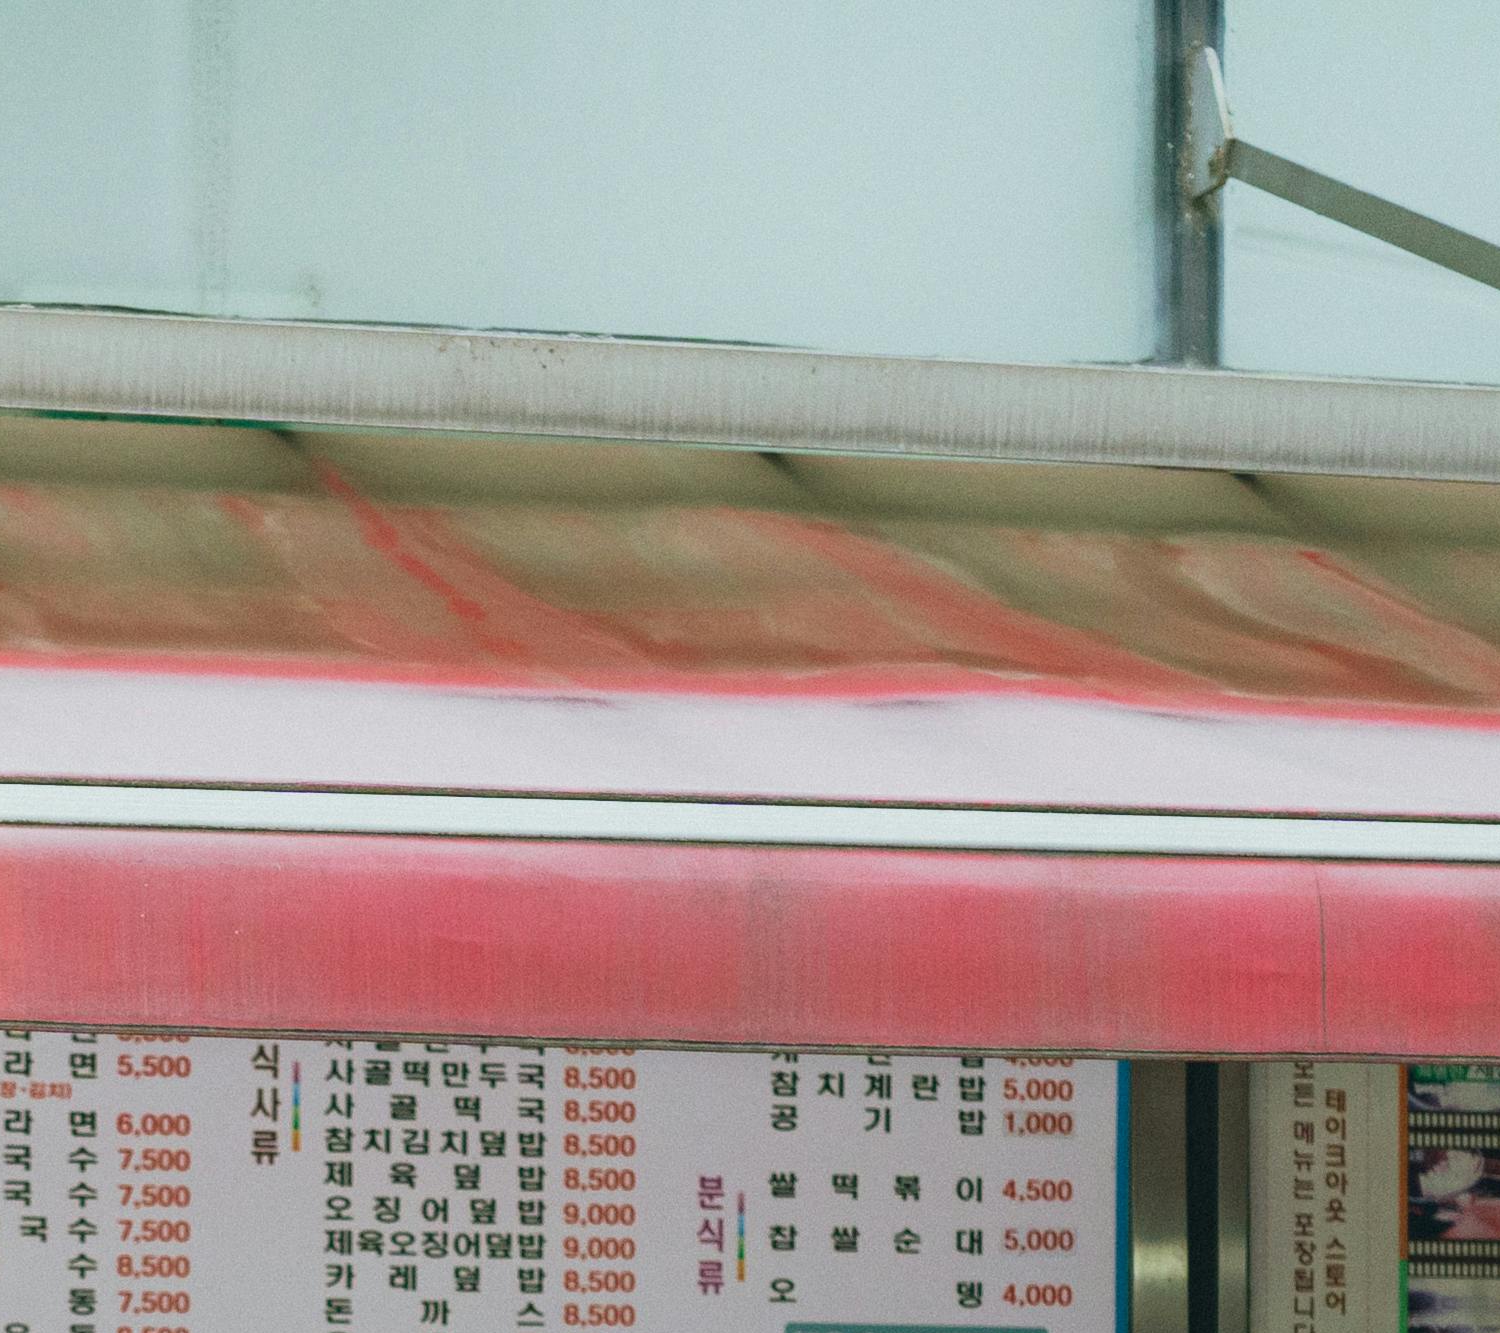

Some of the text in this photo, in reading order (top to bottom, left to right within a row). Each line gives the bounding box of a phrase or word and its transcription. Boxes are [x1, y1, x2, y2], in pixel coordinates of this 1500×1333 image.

[117, 1054, 191, 1078] 5,500
[326, 1059, 636, 1090] 사골떡만두국 8,500
[772, 1071, 1074, 1102] 참치계란밥 5,000
[251, 1044, 280, 1166] 식사류
[325, 1093, 636, 1124] 사골떡국 8,500
[771, 1104, 1074, 1136] 공기밥 1,000
[116, 1113, 191, 1136] 6,000
[326, 1127, 636, 1158] 참치김치덮밥 8,500
[118, 1148, 191, 1172] 7,500
[325, 1161, 636, 1192] 제육덮밥 8,500
[1002, 1179, 1073, 1202] 4,500
[119, 1184, 191, 1209] 7,500
[325, 1196, 636, 1226] 오징어덮밥 9,000
[119, 1219, 191, 1243] 7,500
[325, 1230, 636, 1260] 제육오징어덮밥 9,000
[697, 1176, 724, 1295] 분식류
[769, 1225, 1075, 1255] 찹쌀순대 5,000
[117, 1254, 191, 1279] 8,500
[327, 1264, 636, 1294] 카레덮밥 8,500
[118, 1290, 190, 1314] 7,500
[1003, 1284, 1073, 1307] 4,000
[325, 1298, 636, 1327] 돈까스 8,500
